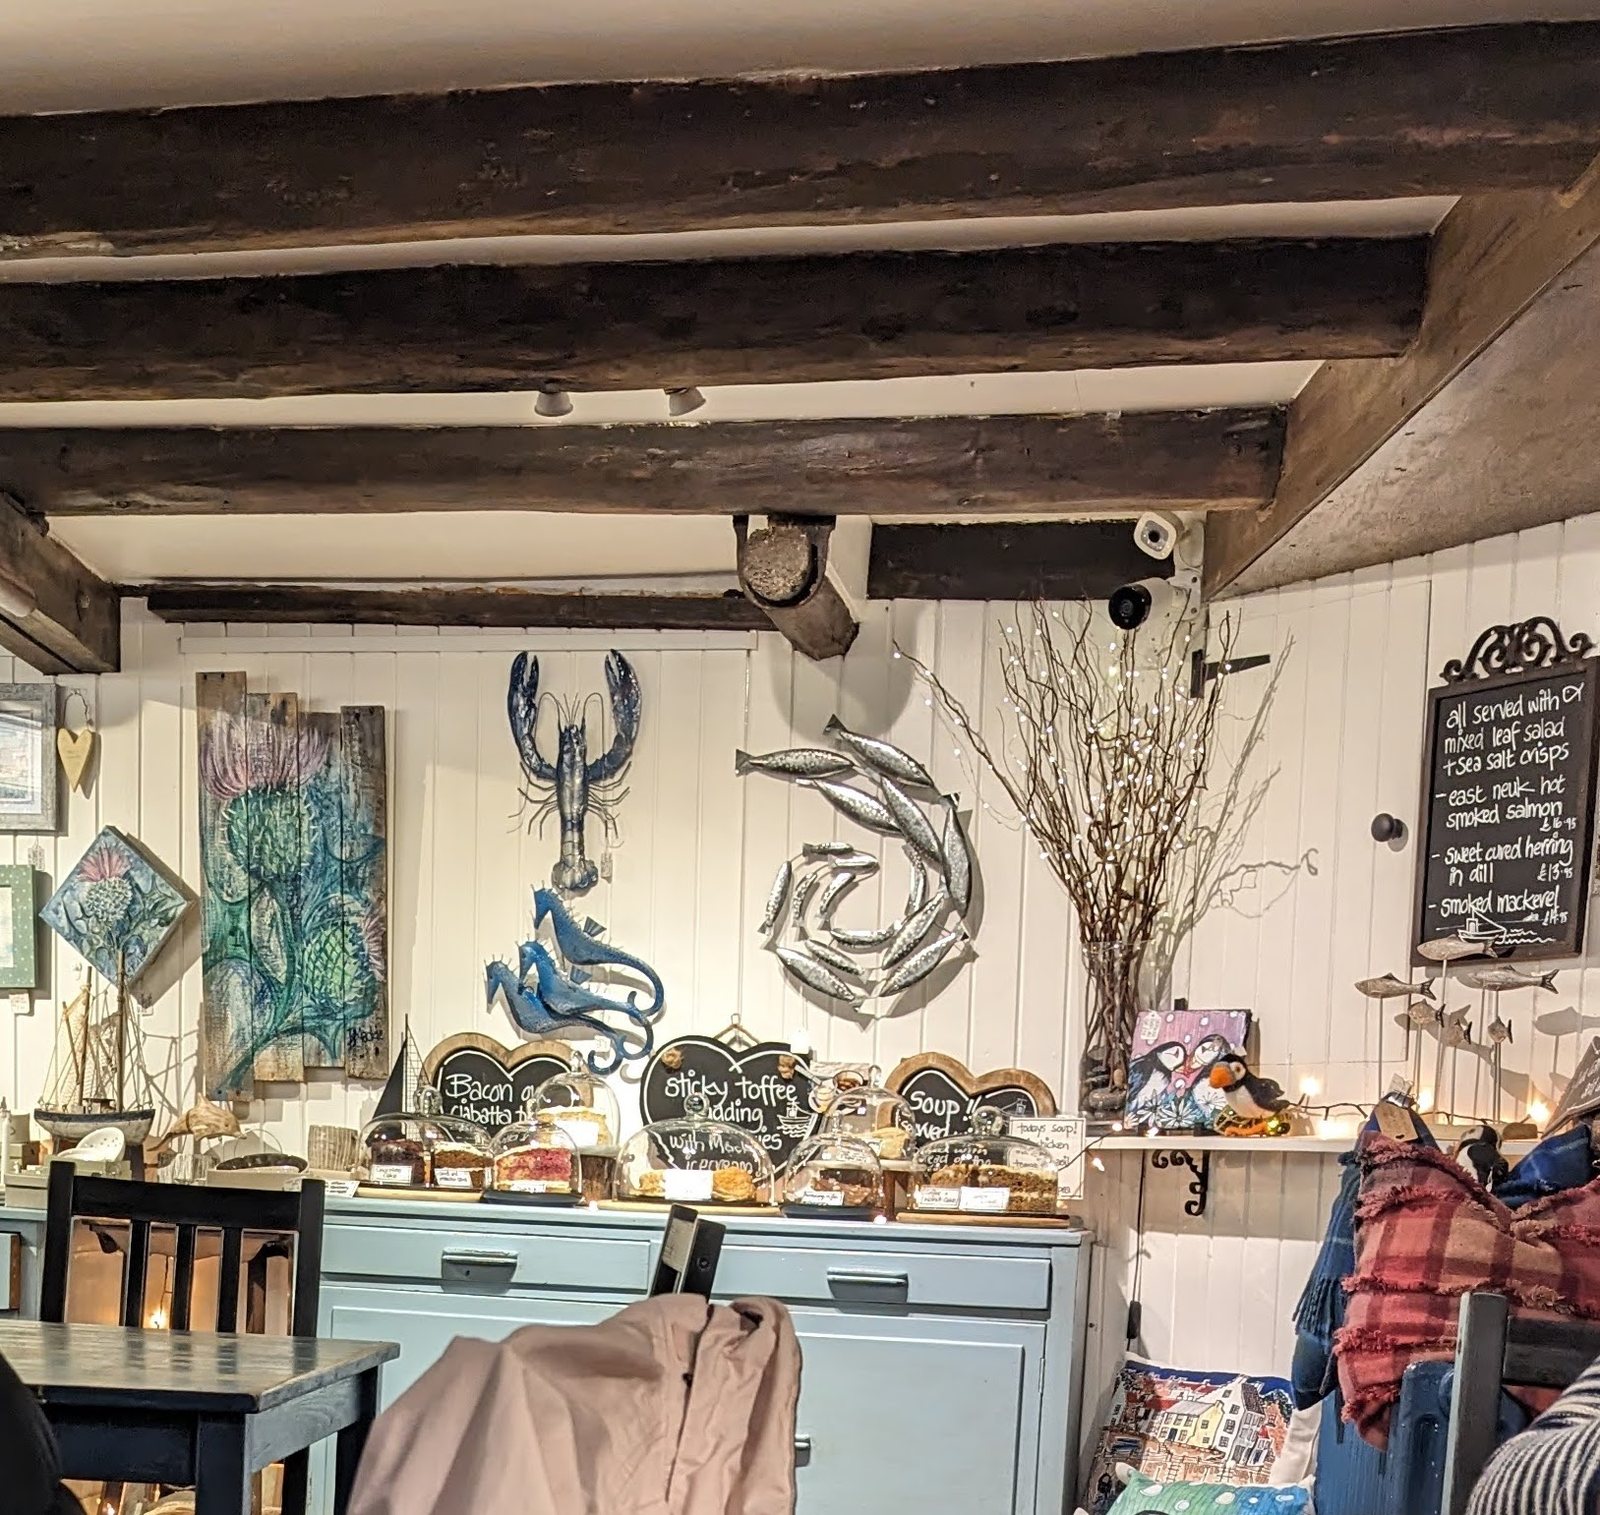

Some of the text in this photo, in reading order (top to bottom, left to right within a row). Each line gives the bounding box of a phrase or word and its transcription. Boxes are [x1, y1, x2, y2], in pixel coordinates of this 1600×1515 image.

[1447, 689, 1559, 729] all served with
[1445, 716, 1565, 754] mixed leaf salad
[1486, 749, 1515, 771] salt
[1519, 740, 1570, 771] crisps
[1449, 788, 1488, 807] east
[1492, 776, 1536, 801] neuk
[1540, 775, 1566, 796] hot
[1446, 800, 1563, 831] smoked salmon
[1444, 842, 1484, 866] sweet
[1525, 831, 1574, 867] herring
[1449, 865, 1464, 887] in
[1469, 862, 1494, 884] dill
[1441, 891, 1493, 918] smoked
[1497, 884, 1560, 913] mackerel
[445, 1073, 513, 1103] Bacon
[664, 1069, 798, 1109] sticky toffee
[450, 1098, 513, 1126] ciabatta
[669, 1129, 705, 1153] with
